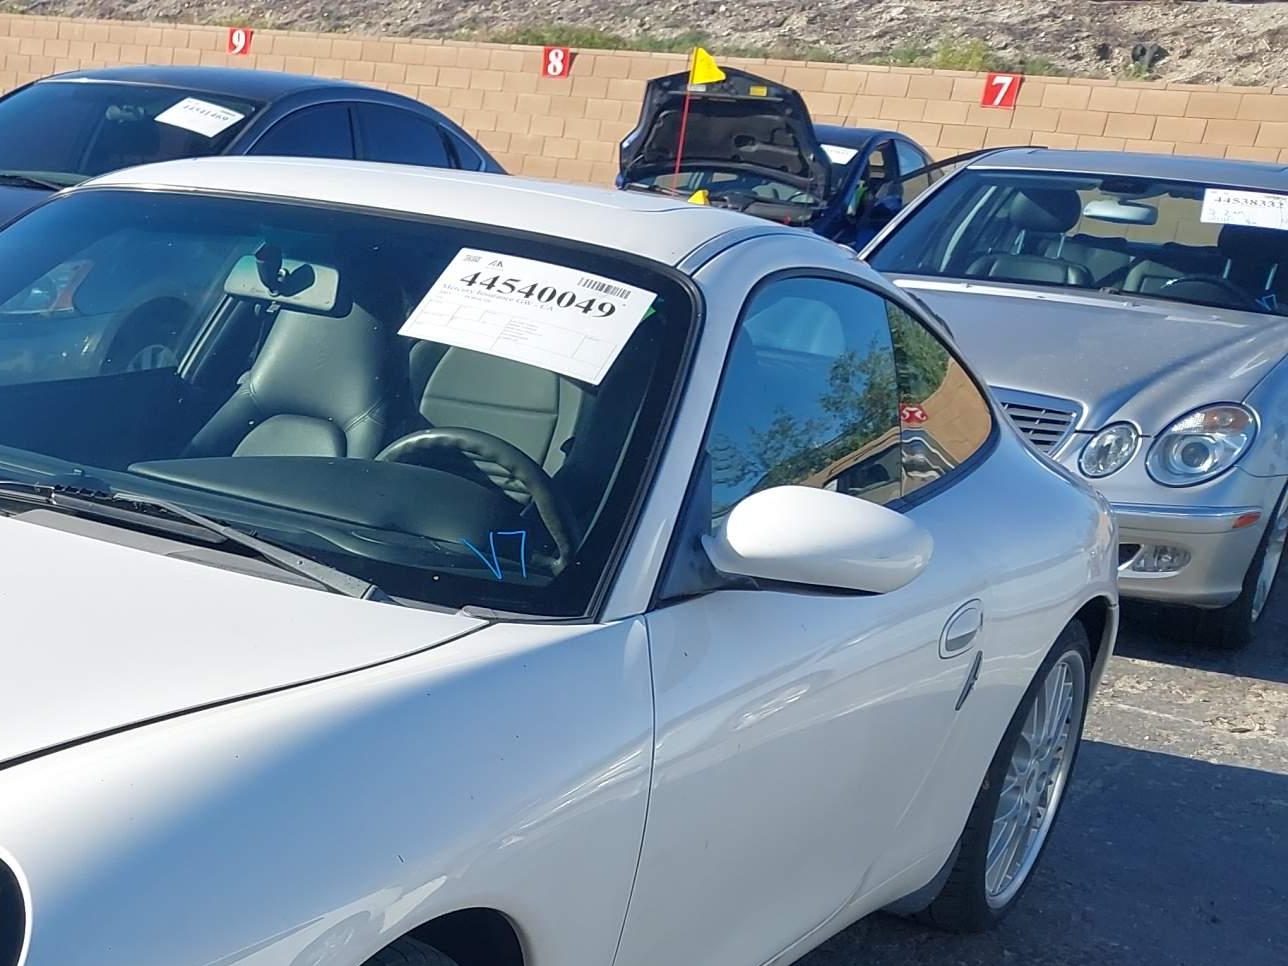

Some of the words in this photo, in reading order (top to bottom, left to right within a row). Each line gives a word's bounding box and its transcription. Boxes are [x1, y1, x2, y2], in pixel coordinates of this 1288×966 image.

[231, 29, 246, 54] 9
[547, 49, 564, 76] 8
[991, 75, 1014, 107] 7
[460, 271, 616, 319] 44540049
